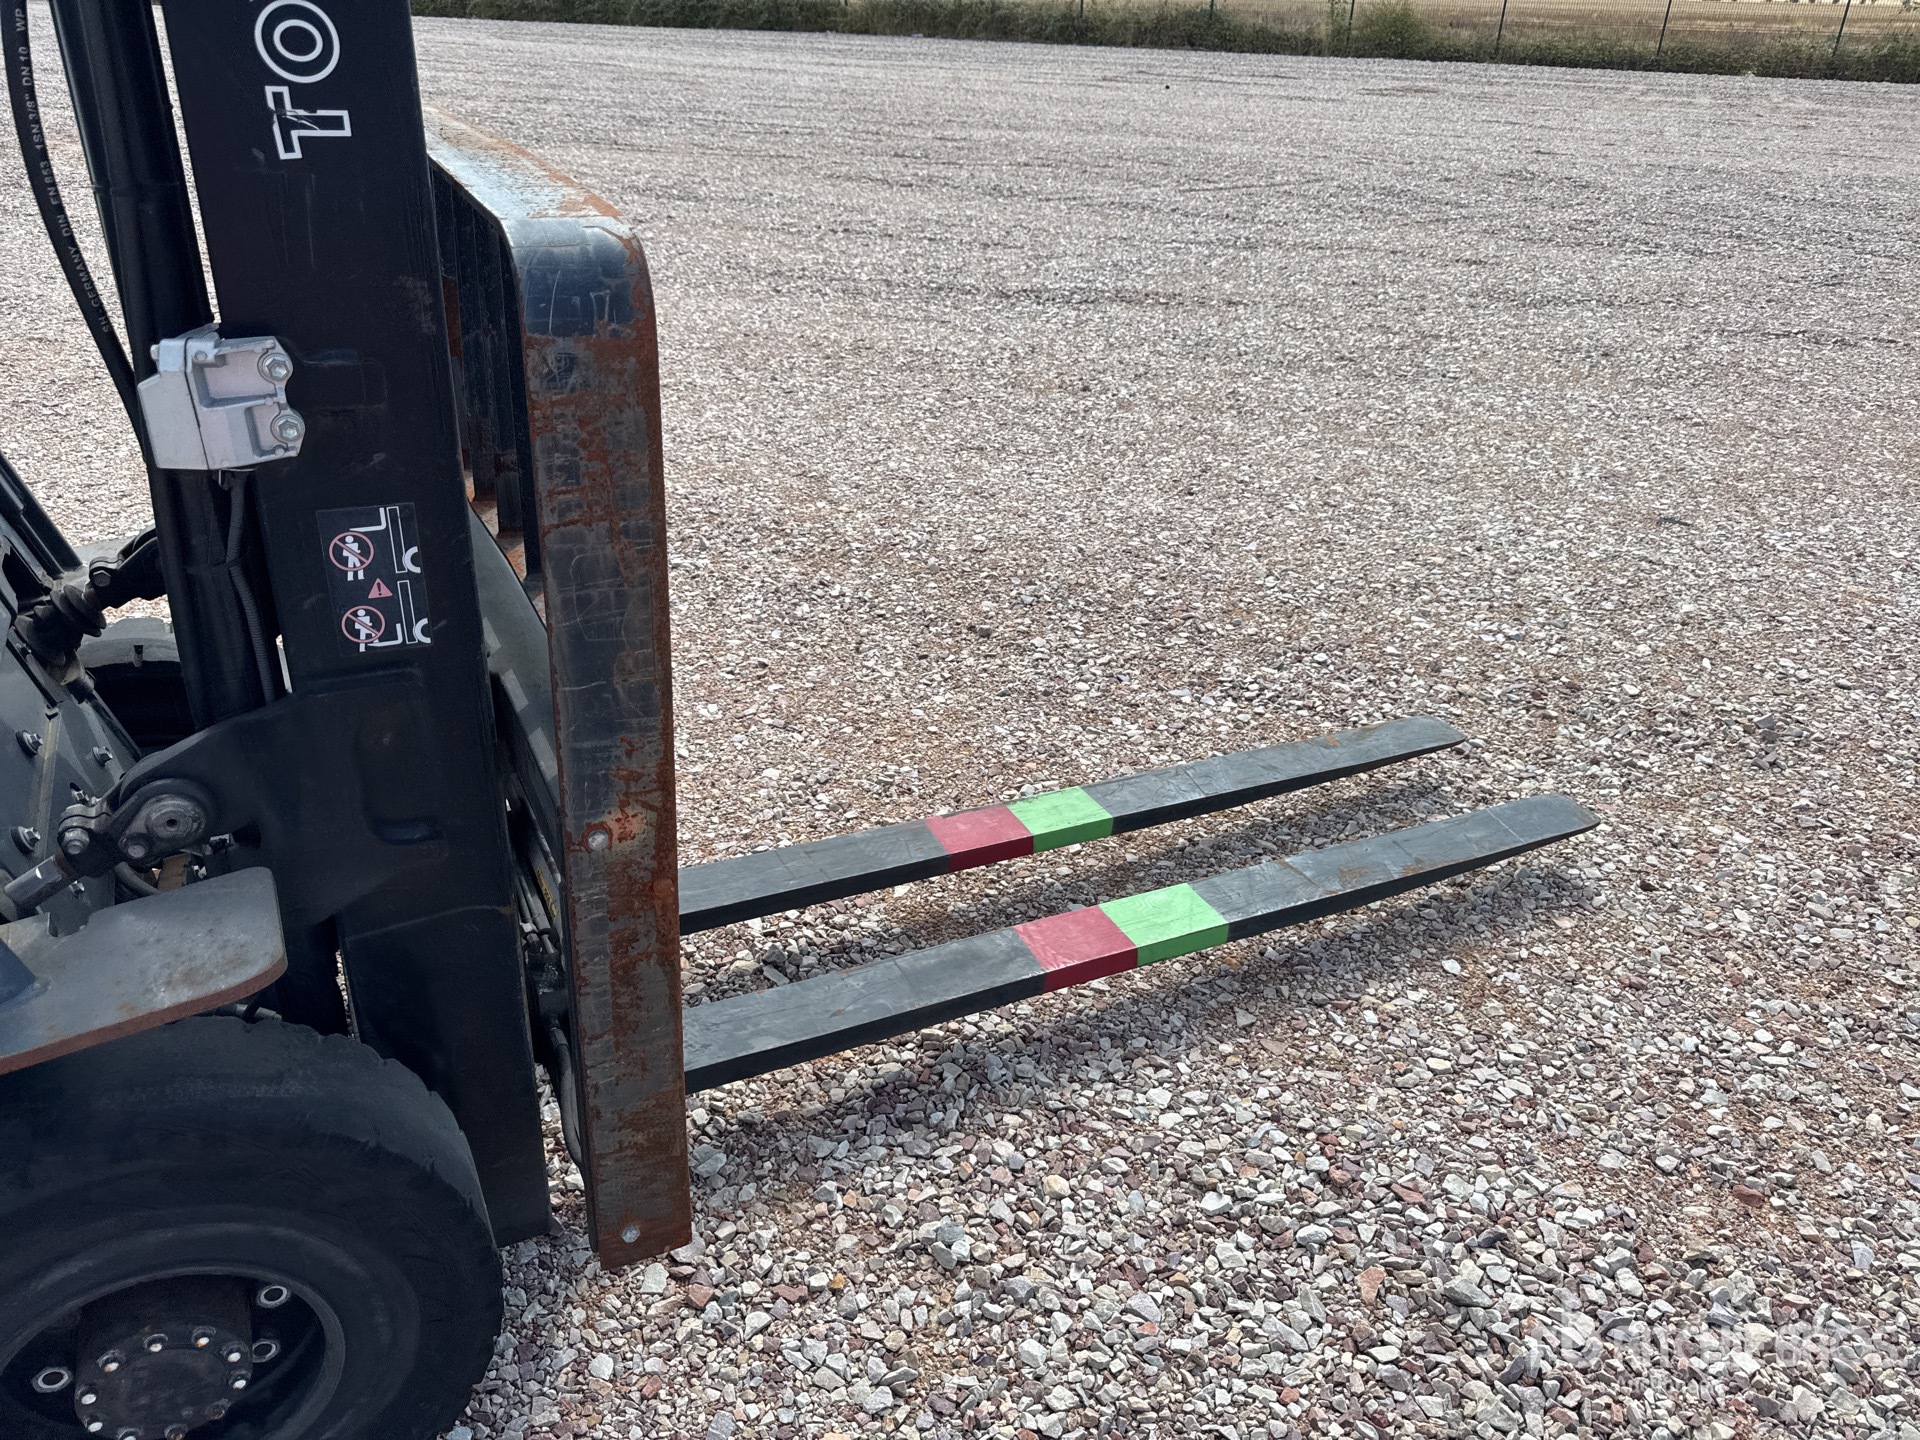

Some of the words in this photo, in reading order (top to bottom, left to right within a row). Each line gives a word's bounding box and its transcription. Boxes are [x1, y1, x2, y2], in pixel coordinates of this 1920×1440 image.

[14, 8, 26, 31] WP
[18, 46, 30, 61] 10
[20, 66, 33, 86] DN
[30, 124, 45, 150] 1SN
[40, 160, 54, 184] 853
[47, 186, 60, 205] EN
[56, 214, 72, 237] DIN
